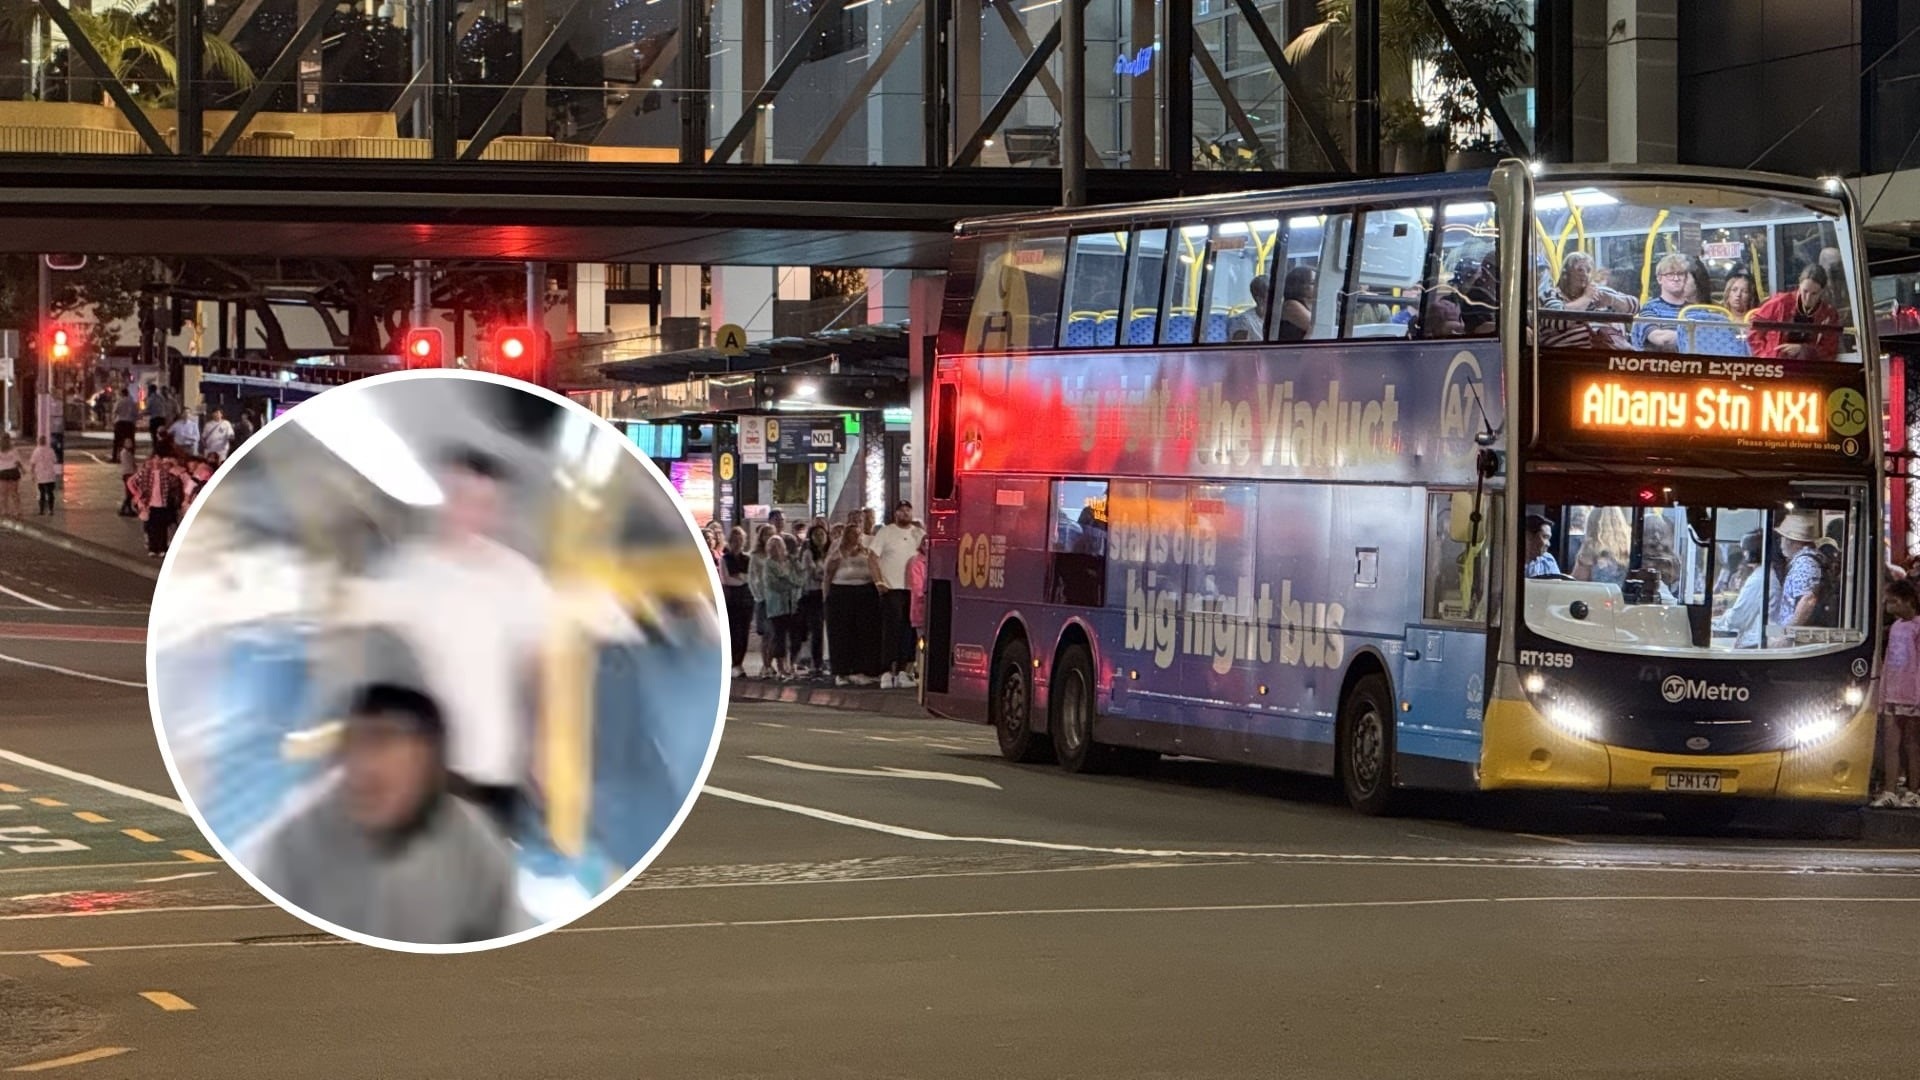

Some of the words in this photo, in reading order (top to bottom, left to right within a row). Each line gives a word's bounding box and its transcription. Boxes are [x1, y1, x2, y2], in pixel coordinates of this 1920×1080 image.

[724, 331, 739, 349] A
[1608, 356, 1703, 374] Northern
[1708, 361, 1785, 381] Express
[1582, 382, 1688, 429] Albany
[1695, 387, 1750, 431] Stn
[1761, 390, 1821, 434] NX1
[1197, 381, 1252, 466] the
[1257, 380, 1400, 468] Viaduct
[812, 432, 833, 445] NX1
[1737, 438, 1764, 447] Please
[1765, 440, 1788, 449] signal
[1789, 440, 1813, 449] driver
[1824, 443, 1841, 452] stop
[1109, 513, 1170, 564] starts
[1173, 521, 1201, 566] on
[1203, 522, 1218, 567] a
[958, 532, 990, 589] GO
[1124, 568, 1177, 670] big
[1183, 574, 1274, 675] night
[1280, 579, 1346, 670] bus
[1519, 650, 1574, 668] RT1359
[1686, 679, 1750, 702] Metro
